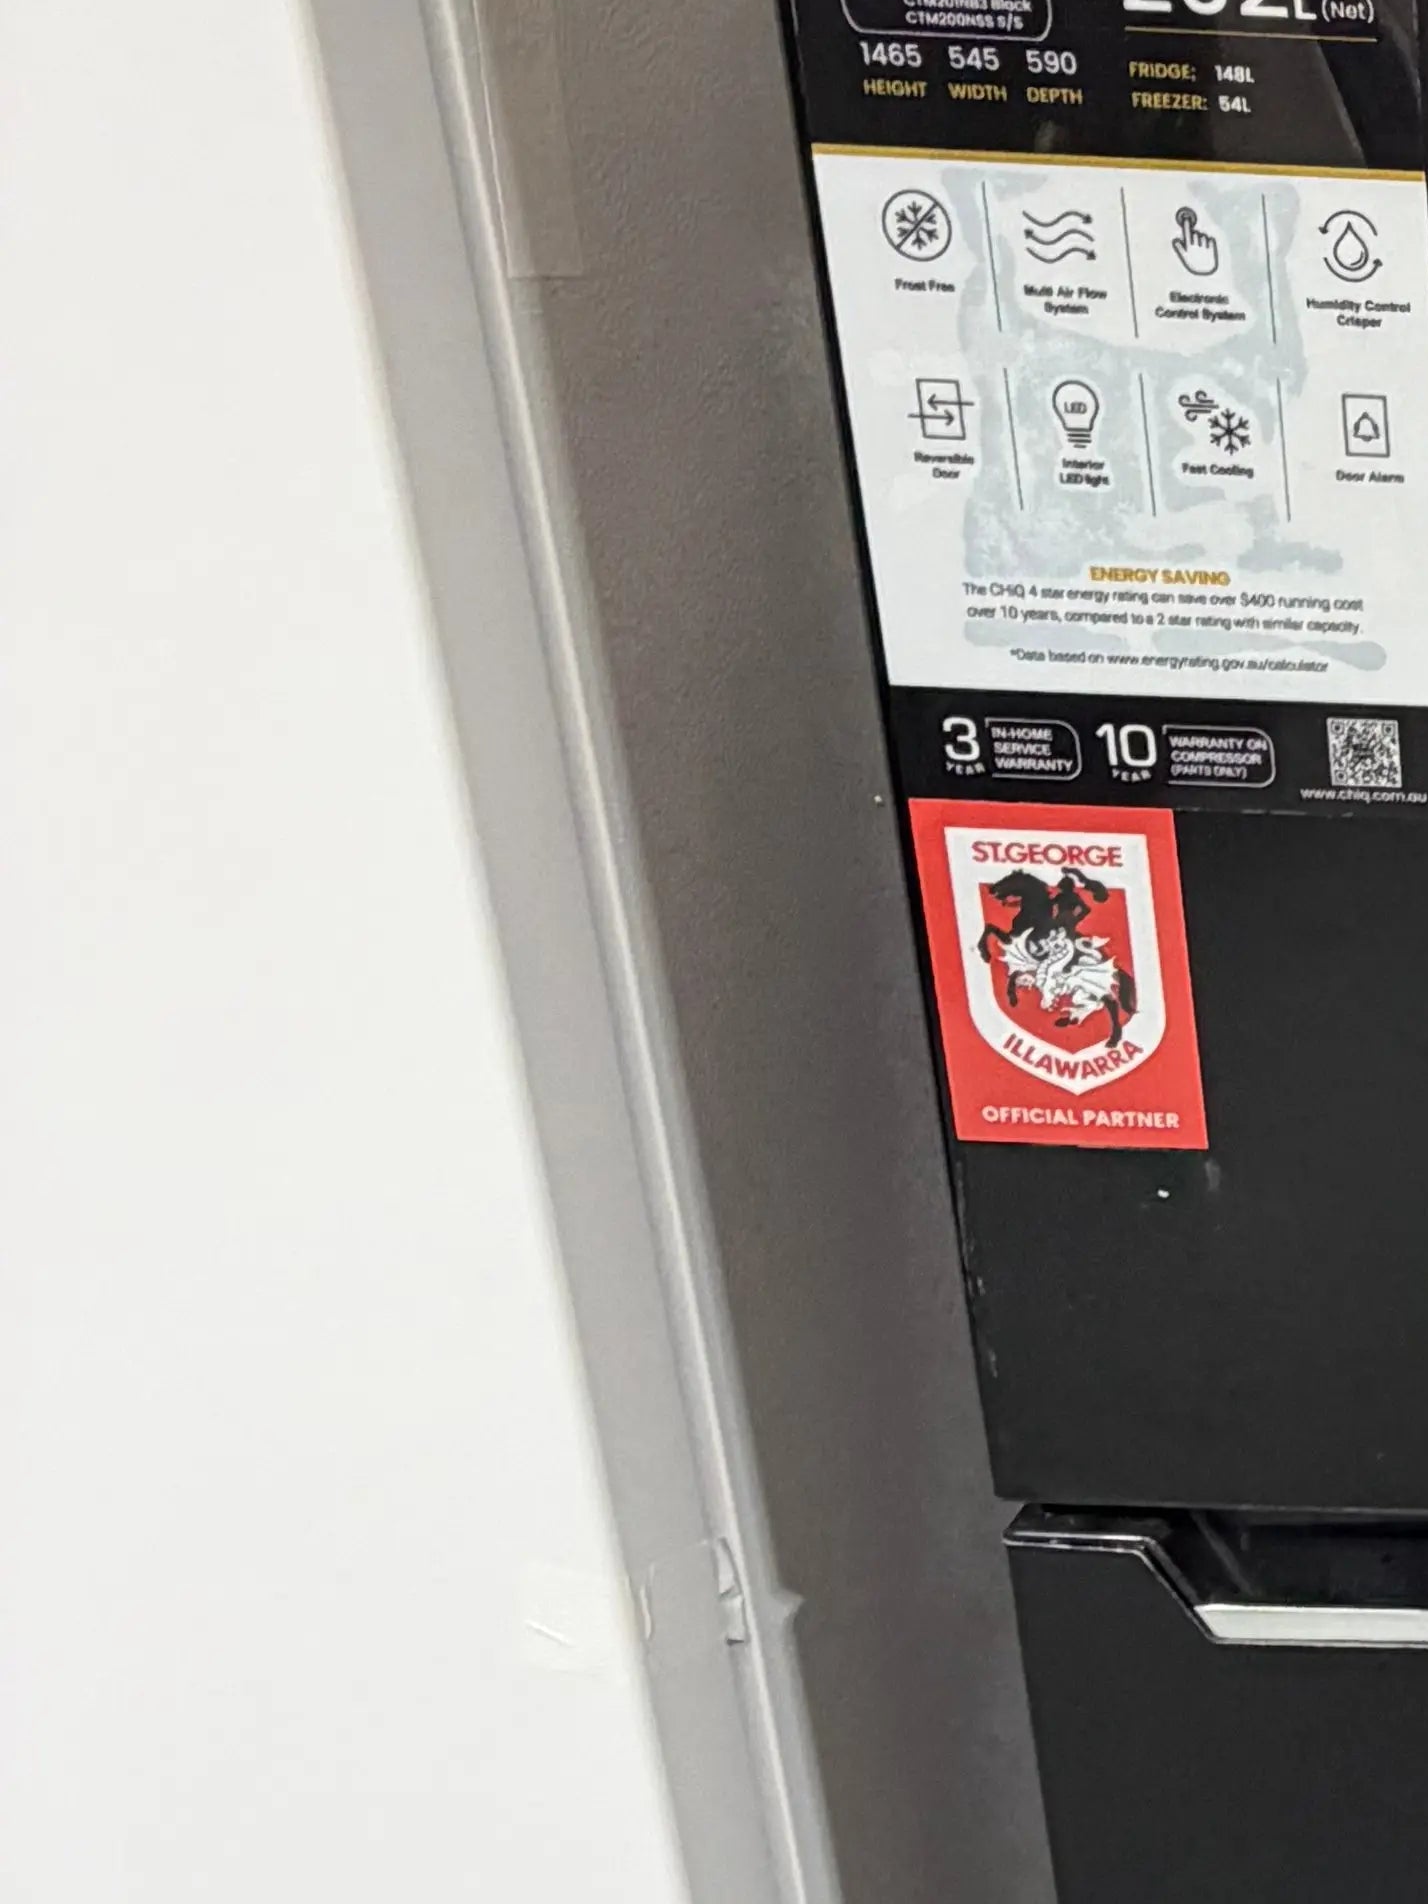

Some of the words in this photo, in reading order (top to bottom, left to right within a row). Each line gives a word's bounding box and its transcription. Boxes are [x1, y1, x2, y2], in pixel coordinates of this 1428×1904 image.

[860, 41, 922, 68] 1465
[948, 46, 999, 71] 545
[1026, 50, 1077, 75] 590
[1214, 64, 1255, 83] 148L
[864, 79, 927, 98] HEIGHT
[948, 83, 1007, 102] WIDTH
[1027, 87, 1083, 104] DEPTH
[1131, 91, 1208, 110] FREEZER:
[1218, 95, 1251, 113] 54L
[1057, 286, 1074, 298] Air
[1155, 306, 1199, 319] Control
[1365, 299, 1411, 313] Control
[1064, 401, 1087, 414] LED
[932, 467, 960, 479] Door
[1059, 472, 1083, 485] LED
[1336, 469, 1365, 482] Door
[1368, 470, 1404, 483] Alarm
[1090, 566, 1158, 583] ENERGY
[1162, 569, 1231, 586] SAVING
[962, 582, 987, 596] The
[1028, 585, 1038, 597] 4
[1066, 589, 1109, 604] energy
[1151, 593, 1175, 604] can
[1209, 595, 1236, 606] over
[1278, 595, 1331, 613] running
[967, 607, 996, 619] over
[1001, 605, 1018, 619] 10
[1064, 610, 1128, 625] compared
[1157, 613, 1165, 625] 2
[1049, 649, 1085, 664] based
[1088, 653, 1104, 664] on
[943, 717, 980, 762] 3
[991, 727, 1053, 742] IN-HOME
[993, 741, 1052, 756] SERVICE
[1095, 723, 1157, 767] 10
[1169, 735, 1244, 751] WARRANTY
[1247, 738, 1268, 752] ON
[995, 757, 1073, 772] WARRANTY
[1171, 751, 1262, 766] COMPRESSOR
[946, 761, 986, 776] YEAR
[1112, 768, 1151, 783] YEAR
[1300, 788, 1428, 804] www.chiq.com.au
[1003, 1033, 1144, 1080] ILLAWARRA
[981, 1105, 1079, 1125] OFFICIAL
[1082, 1109, 1180, 1129] PARTNER
